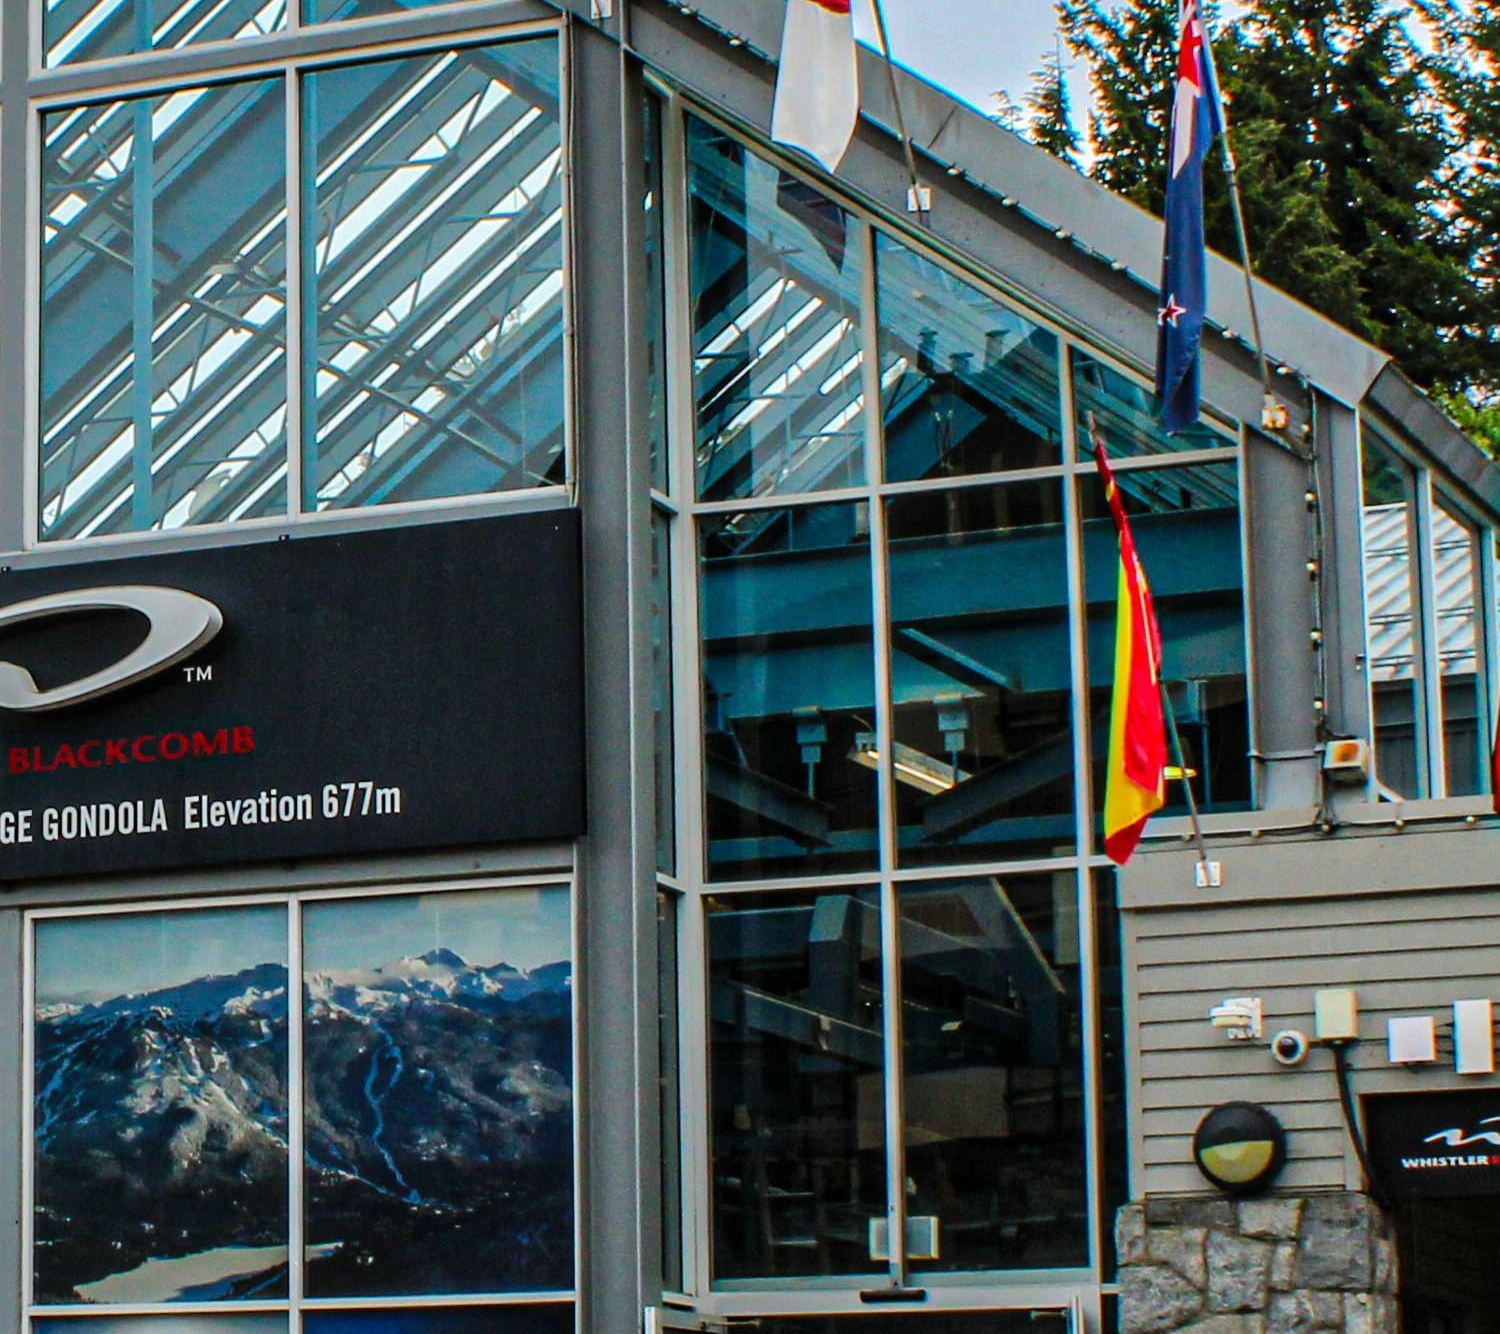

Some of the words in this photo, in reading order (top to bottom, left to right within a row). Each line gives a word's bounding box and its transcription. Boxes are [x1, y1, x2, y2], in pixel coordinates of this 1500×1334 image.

[182, 665, 213, 682] TM
[7, 724, 257, 776] BLACKCOMB
[41, 798, 169, 840] GONDOLA
[183, 788, 314, 830] Elevation
[320, 781, 403, 822] 677m
[1400, 1154, 1488, 1170] WHISTLER
